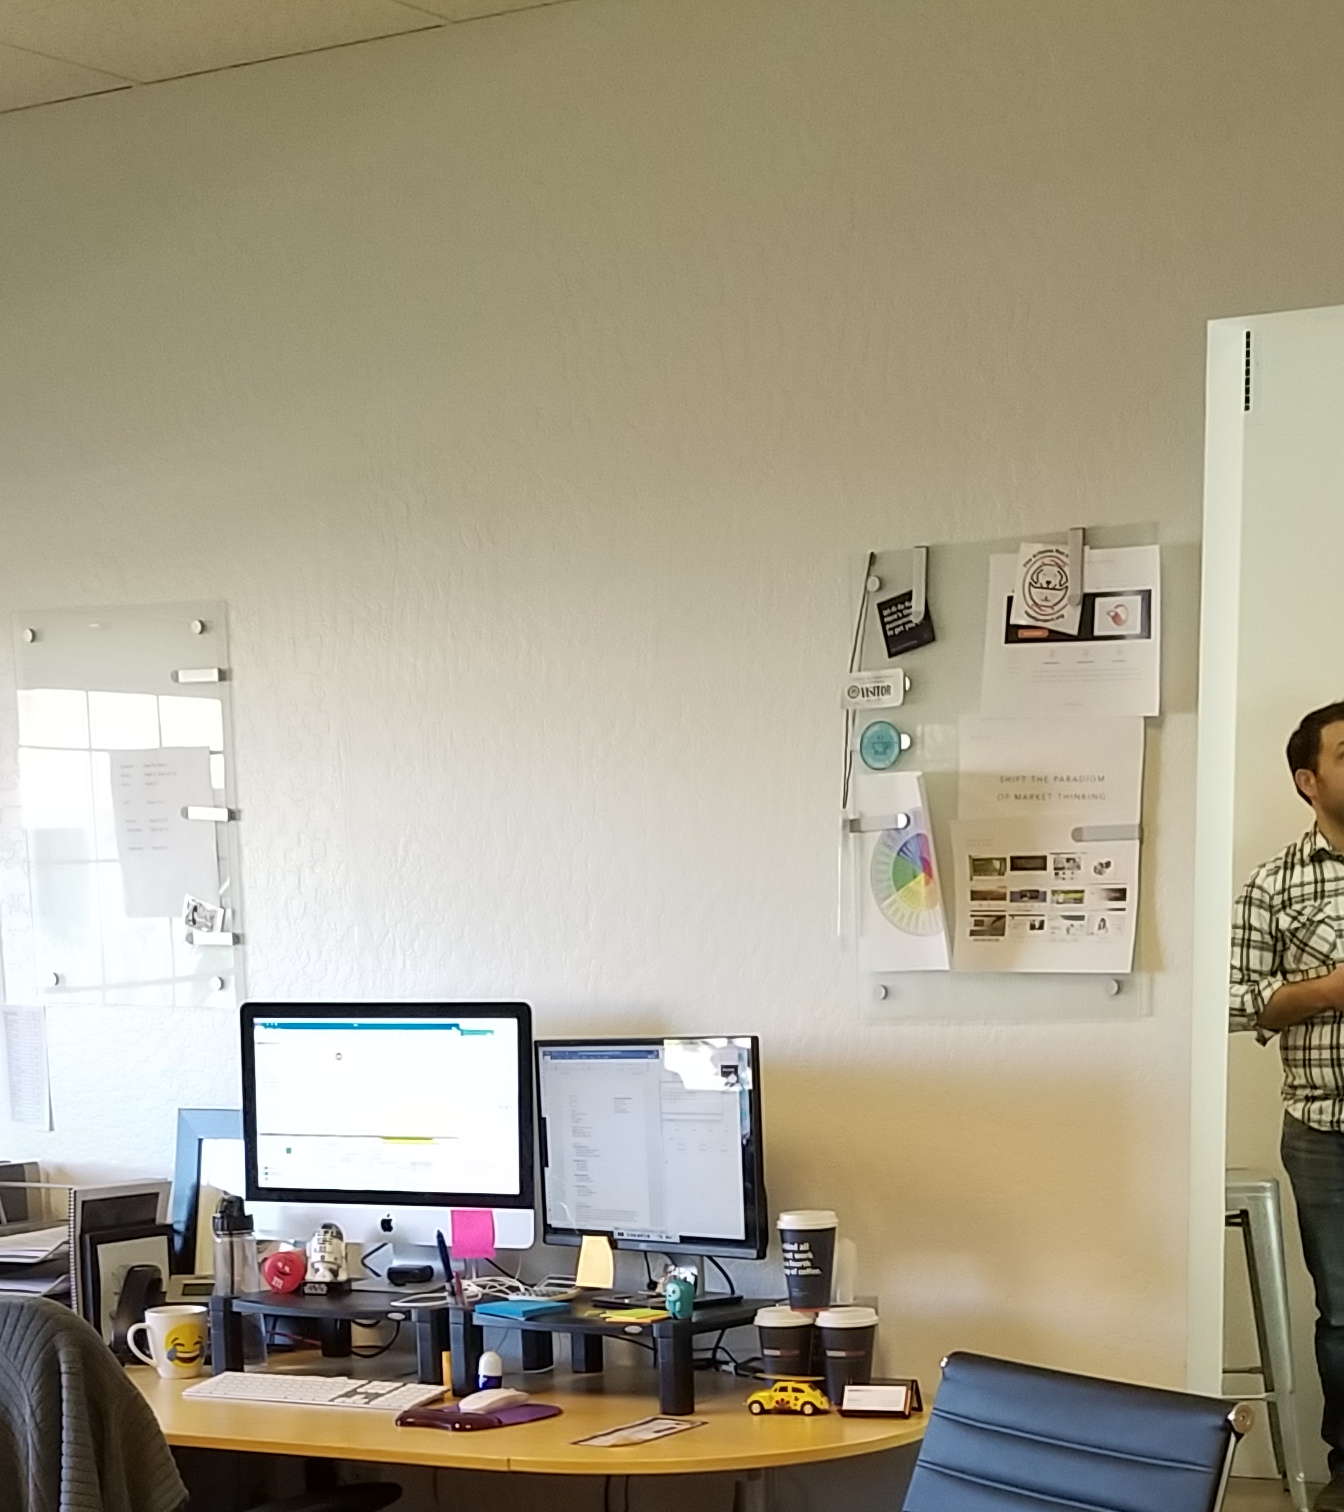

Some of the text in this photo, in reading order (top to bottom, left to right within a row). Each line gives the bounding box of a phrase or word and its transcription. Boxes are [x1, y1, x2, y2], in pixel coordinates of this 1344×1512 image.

[999, 774, 1105, 783] SHIFT THE PARADIGM
[997, 792, 1106, 801] OF MARKET THINKING
